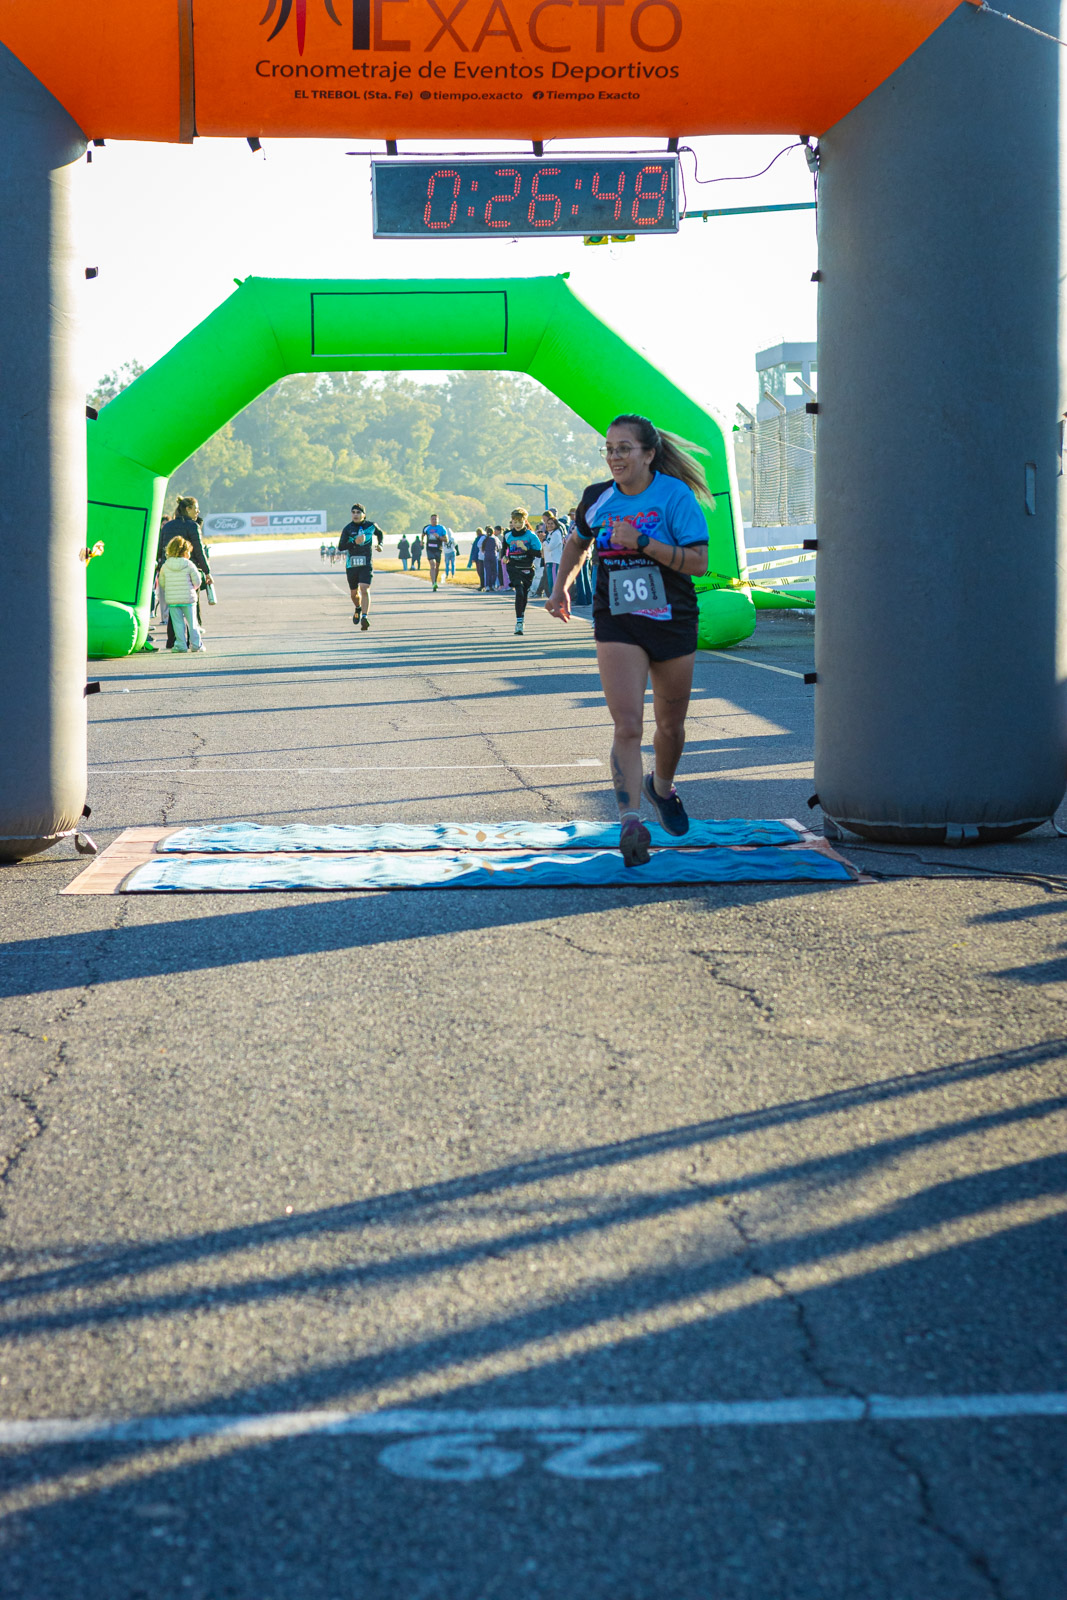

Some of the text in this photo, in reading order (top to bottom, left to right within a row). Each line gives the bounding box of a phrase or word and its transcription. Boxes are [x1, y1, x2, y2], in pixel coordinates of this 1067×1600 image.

[255, 60, 680, 83] Cronometraje de Eventos Deportivos
[294, 90, 414, 101] EL TREBOL (Sta. Fe)
[433, 91, 523, 102] tiempo.exacto
[547, 90, 641, 101] Tiempo Exacto
[423, 166, 669, 229] 0:26:48
[214, 518, 239, 529] Ford
[272, 515, 318, 525] LONG
[352, 558, 364, 566] 112
[622, 577, 649, 602] 36
